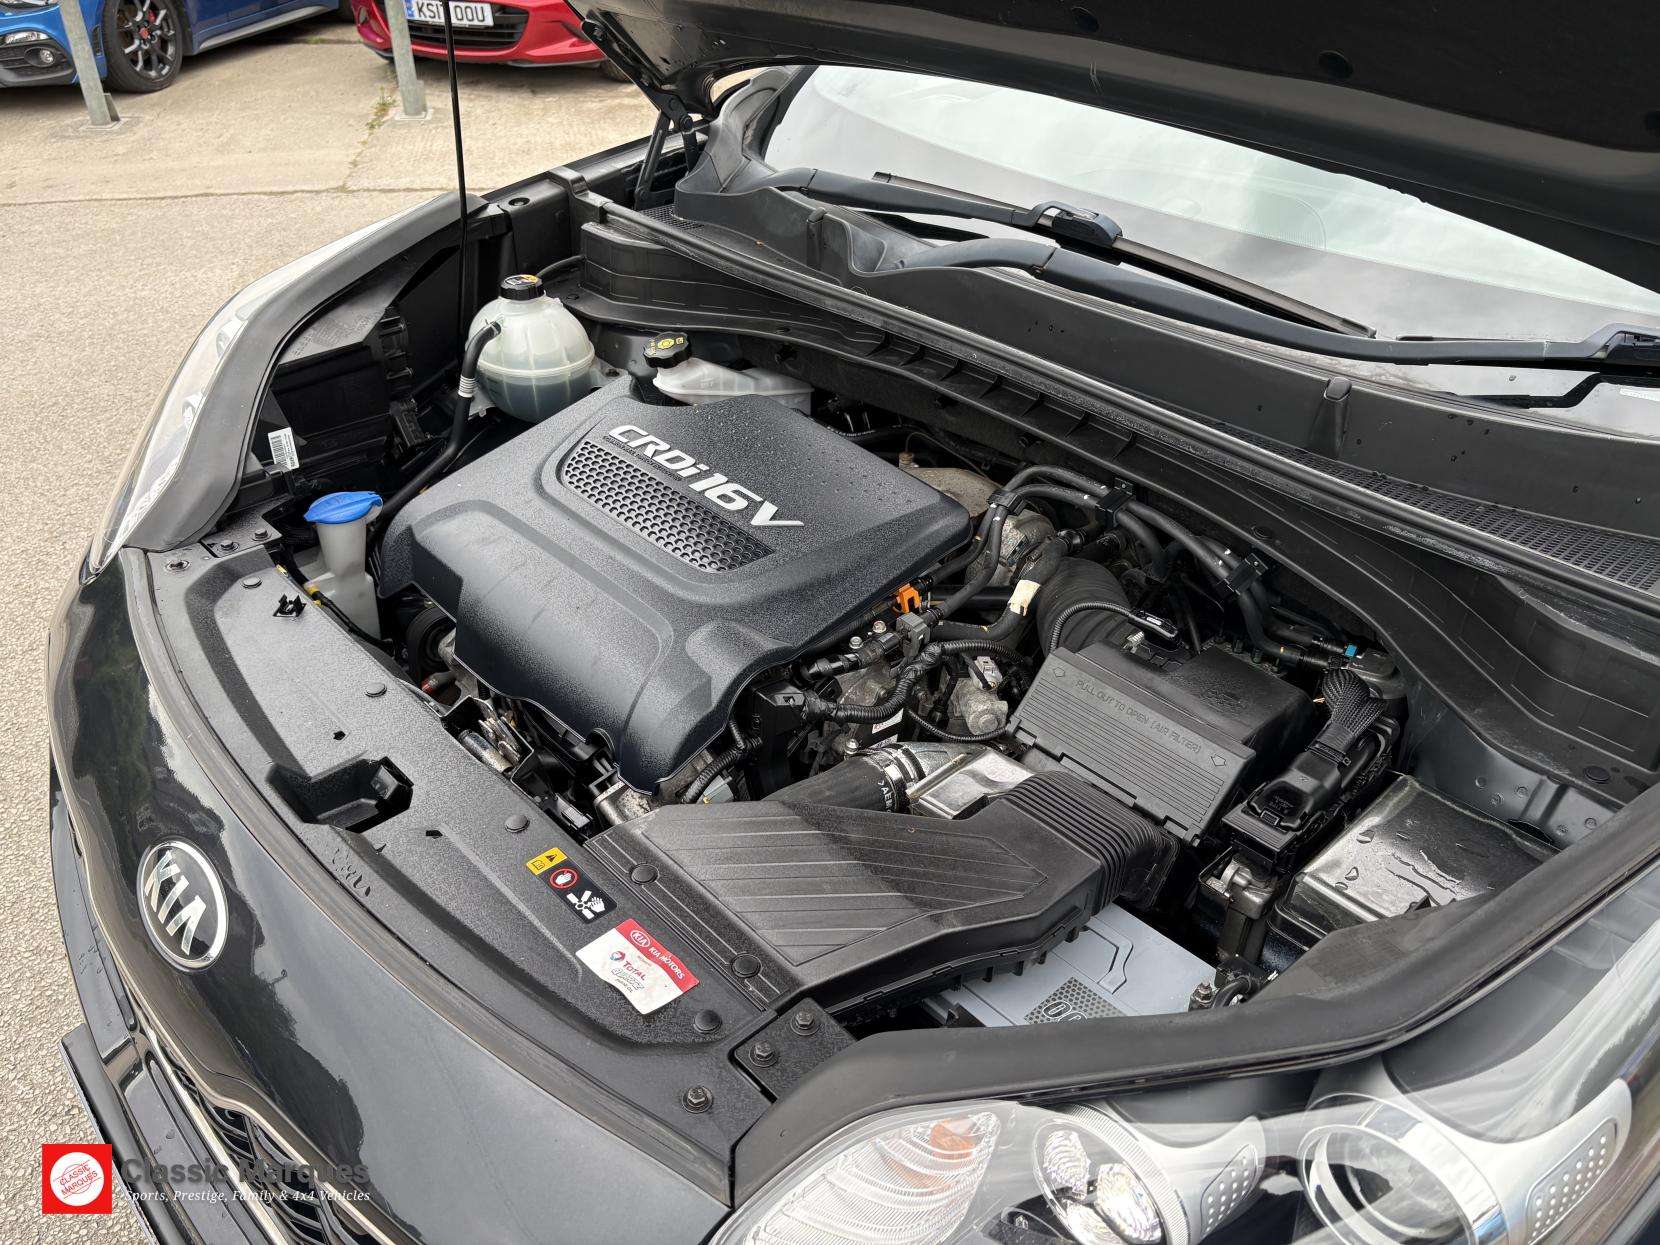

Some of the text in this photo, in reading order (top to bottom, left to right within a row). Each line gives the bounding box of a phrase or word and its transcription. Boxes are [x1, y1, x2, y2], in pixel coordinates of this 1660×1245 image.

[416, 1, 446, 19] KS1
[1076, 679, 1096, 697] PULL
[1096, 690, 1115, 705] OUT
[1114, 699, 1126, 712] TO
[1126, 704, 1150, 725] OPEN
[144, 850, 207, 956] KIA
[632, 931, 648, 947] KIA
[623, 960, 647, 982] TOTAL
[648, 946, 661, 959] KIA
[659, 954, 686, 981] MOTORS
